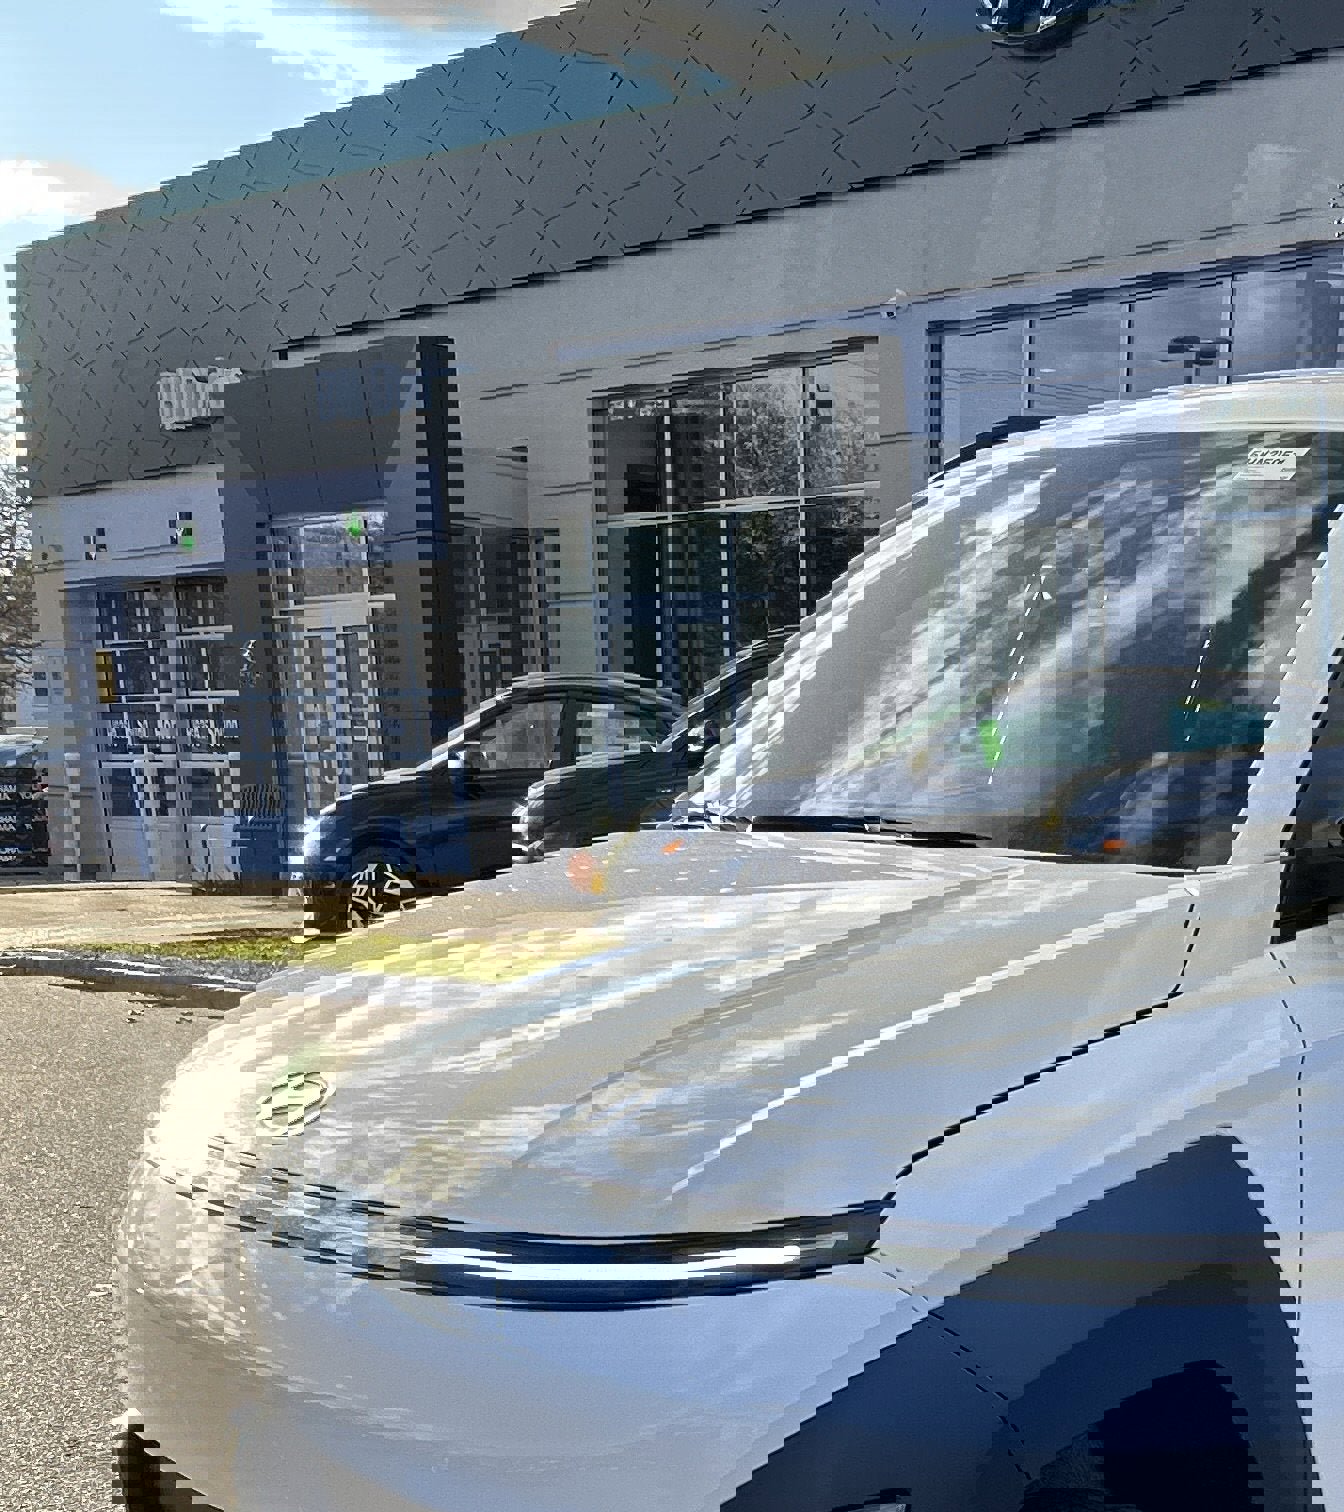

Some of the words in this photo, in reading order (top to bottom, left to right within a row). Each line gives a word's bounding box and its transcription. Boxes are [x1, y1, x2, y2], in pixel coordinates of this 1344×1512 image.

[316, 367, 376, 425] Bill
[372, 356, 483, 419] Dod
[218, 713, 246, 739] Please
[265, 711, 293, 739] Sound
[314, 712, 337, 739] Hor
[377, 711, 408, 739] Please
[430, 711, 462, 739] Sound
